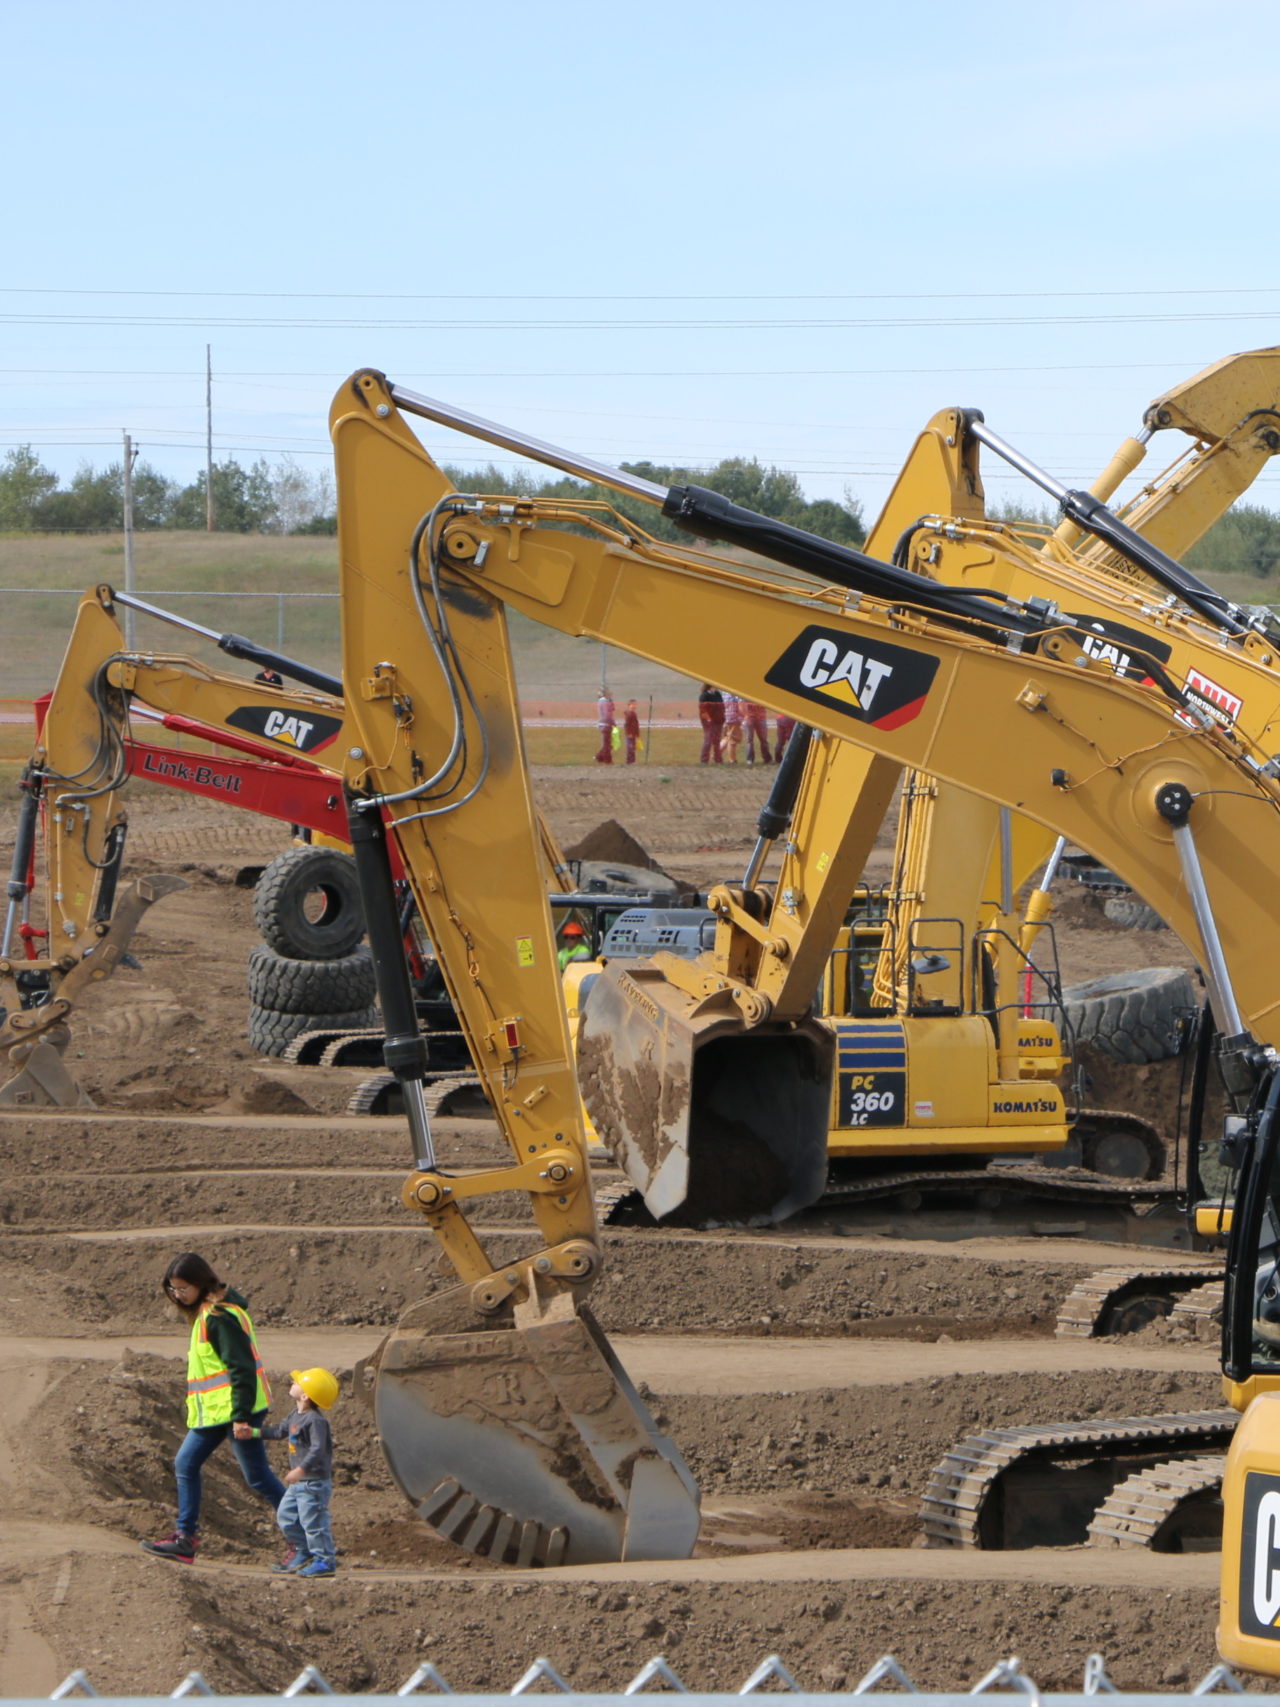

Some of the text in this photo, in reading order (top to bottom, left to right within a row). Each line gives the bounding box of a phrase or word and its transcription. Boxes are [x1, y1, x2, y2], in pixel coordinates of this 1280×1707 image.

[800, 638, 893, 711] CAT
[264, 710, 314, 748] CAT
[143, 753, 242, 793] Link-Belt
[851, 1075, 875, 1090] PC
[850, 1091, 895, 1112] 360
[994, 1098, 1057, 1113] KOMATSU
[850, 1113, 869, 1125] LC
